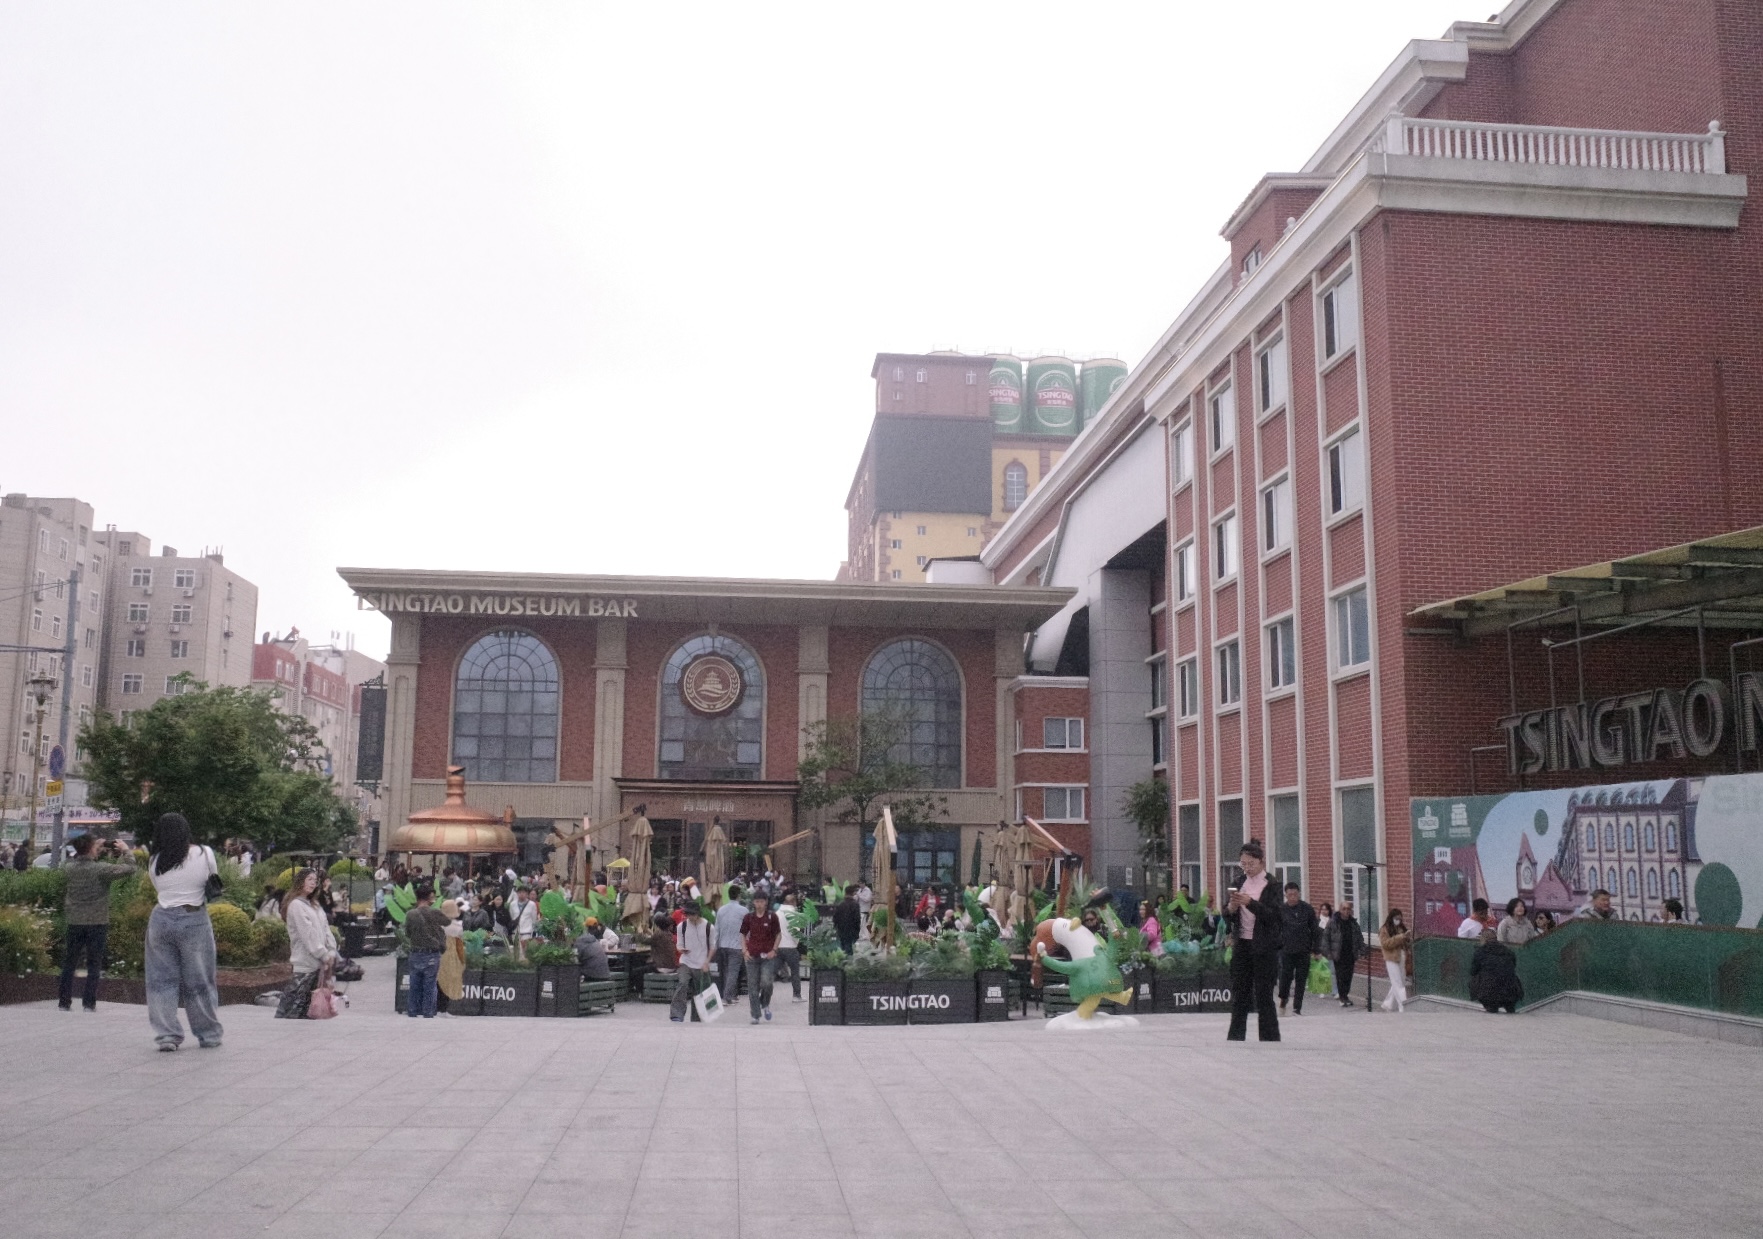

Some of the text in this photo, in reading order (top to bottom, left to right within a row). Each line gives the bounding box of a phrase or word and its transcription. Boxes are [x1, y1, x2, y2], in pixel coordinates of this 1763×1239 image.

[988, 389, 1019, 399] SINGTAO
[1038, 391, 1073, 401] TSINGTAO
[353, 592, 638, 617] TSINGTAO MUSEUM BAR
[1497, 679, 1724, 774] TSINGTAO
[869, 994, 950, 1011] TSINGTAO
[1173, 988, 1232, 1006] TSINGTAO
